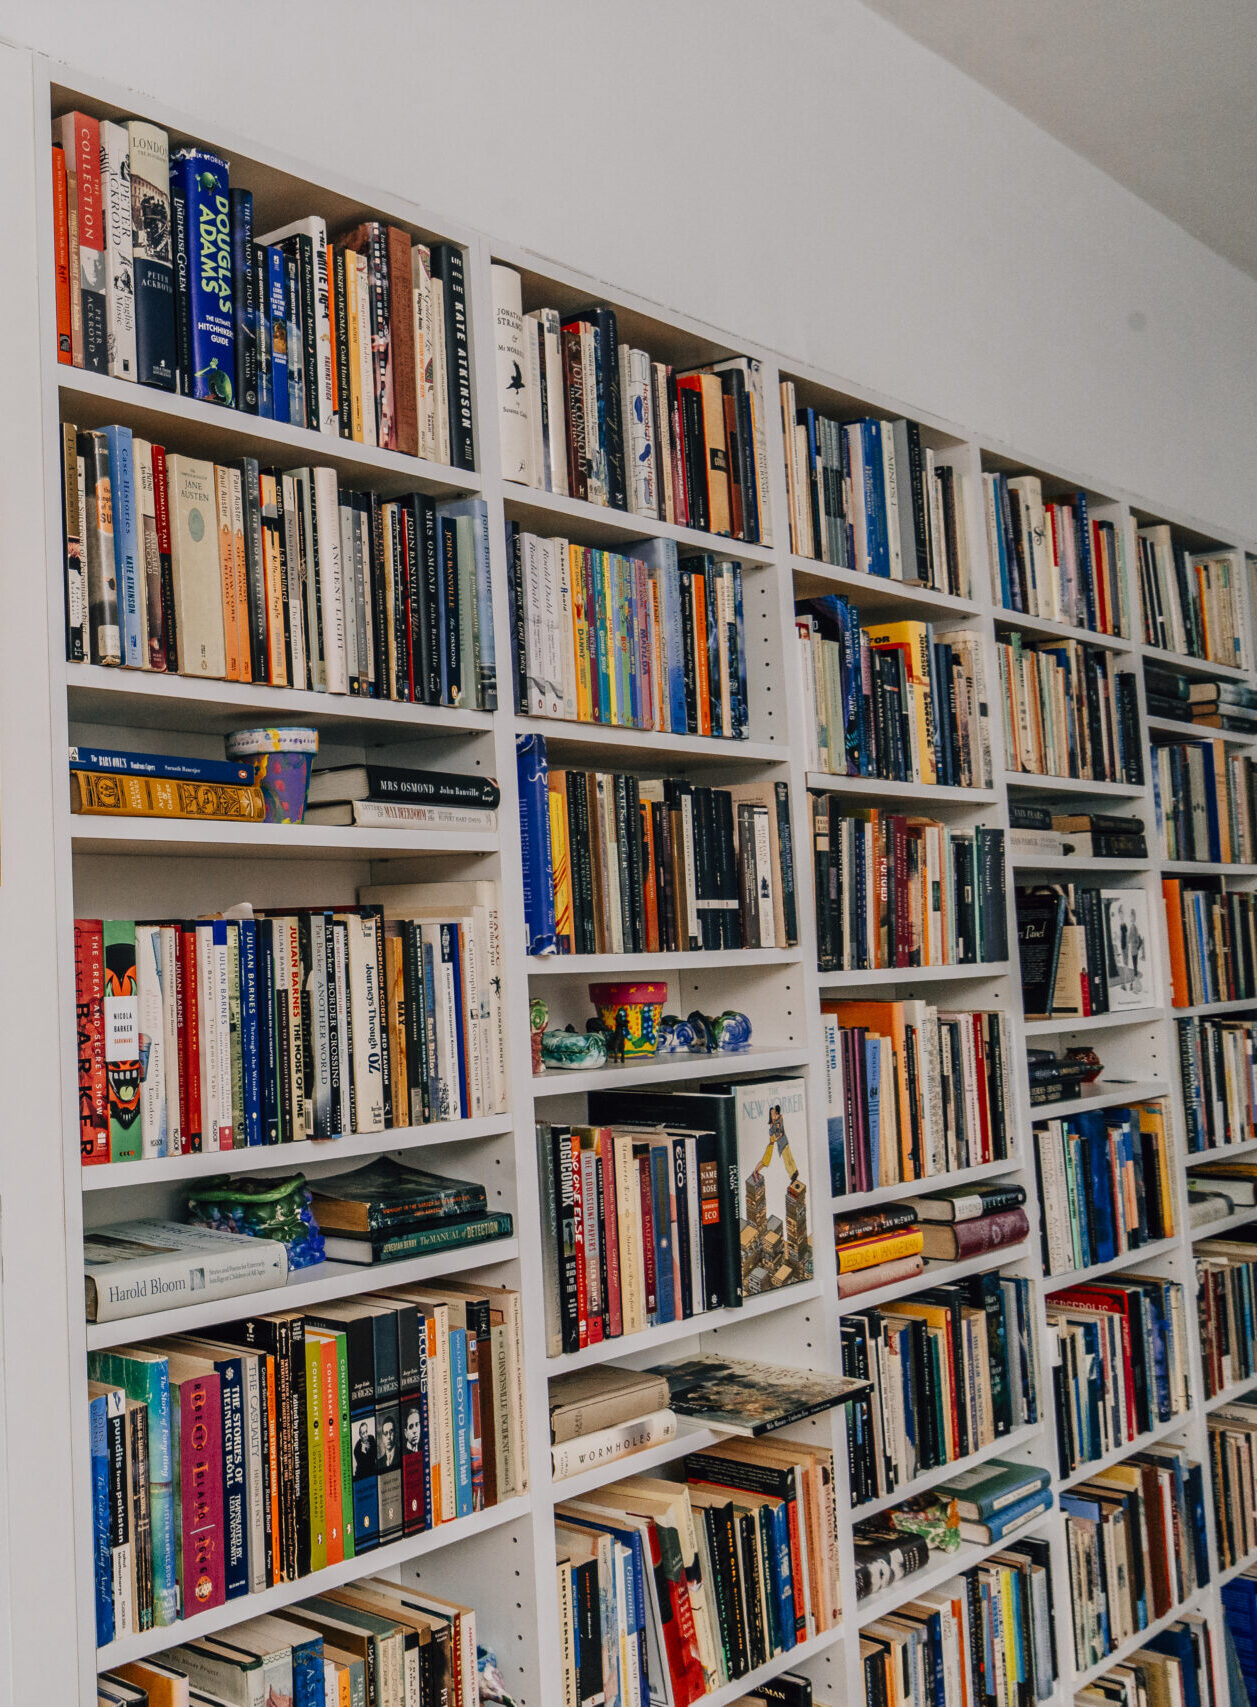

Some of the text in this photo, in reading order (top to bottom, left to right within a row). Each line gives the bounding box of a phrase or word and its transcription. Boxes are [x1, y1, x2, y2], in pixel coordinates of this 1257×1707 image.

[80, 128, 95, 240] COLLECTION
[109, 169, 122, 246] ACKROYD
[120, 182, 132, 238] PETER
[199, 203, 219, 295] ADAMS
[215, 195, 233, 315] DOUGLAS
[243, 203, 255, 321] THE SALMON OF DOUBT
[336, 256, 344, 294] ROBERT
[87, 296, 96, 353] ACKROYD
[94, 309, 103, 344] PETER
[115, 295, 126, 327] Music
[122, 295, 133, 332] English
[210, 334, 230, 346] GUIDE
[337, 296, 347, 342] AICKMAN
[340, 345, 348, 367] Cold
[454, 301, 472, 429] KATE ATKINSON
[342, 390, 349, 399] in
[342, 401, 350, 423] Mine
[571, 361, 588, 474] JOHN CONNOLLY
[642, 382, 652, 442] Hopscotch
[157, 455, 169, 548] THE HANDMAID'S TALE
[180, 490, 209, 502] AUSTEN
[184, 480, 202, 490] JANE
[219, 469, 230, 517] Paul Auster
[233, 473, 243, 522] Paul Auster
[275, 485, 285, 515] crash
[121, 448, 136, 614] Case Histories KATE ATKINSON
[1081, 499, 1091, 550] MURAKAMI
[425, 509, 440, 668] MRS OSMOND John Banville
[528, 542, 541, 609] Roald Dahl
[542, 548, 555, 616] Roald Dahl
[577, 628, 586, 660] DANNY
[588, 625, 597, 660] WITCHES
[599, 630, 609, 674] GOING SOLO
[620, 635, 629, 653] BOY
[639, 628, 650, 676] MATILDA
[918, 633, 934, 749] JOHNSON SMOKE
[380, 779, 480, 797] MRS OSMOND John Banville
[983, 834, 995, 895] My Struggle
[218, 951, 229, 1025] JULIAN BARNES
[245, 930, 260, 1102] JULIAN BARNES Through the Window
[315, 924, 329, 1085] Pat Barker ANOTHER WORLD
[325, 924, 341, 1088] Pat Barker BORDER CROSSING
[364, 963, 381, 1074] Journeys Through OZ
[90, 935, 104, 1116] THE GREAT AND SECRET SHOW
[289, 925, 305, 1119] JULIAN BARNES THE NOISE OF TIME
[427, 1016, 438, 1078] Saul Bellow
[827, 1025, 838, 1070] THE END
[74, 1002, 95, 1156] BARKER
[742, 1099, 765, 1121] NEW
[558, 1134, 575, 1208] LOGICOMIX
[571, 1150, 584, 1246] NO ONE ELSE
[419, 1236, 430, 1246] The
[428, 1231, 461, 1245] MANUAL
[466, 1221, 499, 1239] DETECTION
[585, 1155, 600, 1312] THE BLOODSTONE PAPERS GLEN DUNCAN
[704, 1210, 718, 1221] ECO
[644, 1215, 656, 1284] BAUDOLINO
[109, 1276, 186, 1303] Harold Bloom
[418, 1325, 429, 1395] FICCIONES
[159, 1375, 171, 1477] The Story of Forgetting
[194, 1383, 205, 1452] ROBERTO
[223, 1387, 237, 1489] HEINRICH BÖLL
[232, 1384, 244, 1484] THE STORIES OF
[248, 1362, 261, 1457] THE CASUALTY
[112, 1417, 126, 1544] pundits from pakistan
[578, 1431, 653, 1465] WORMHOLES
[197, 1535, 208, 1575] 2666
[229, 1495, 239, 1567] LEILA VENNEWITZ
[234, 1492, 243, 1559] TRANSLATED BY
[560, 1568, 572, 1660] KERSTIN EKMAN
[625, 1565, 637, 1626] Gloaming
[726, 1520, 745, 1651] GONE GIRL GILLIAN FLYNN
